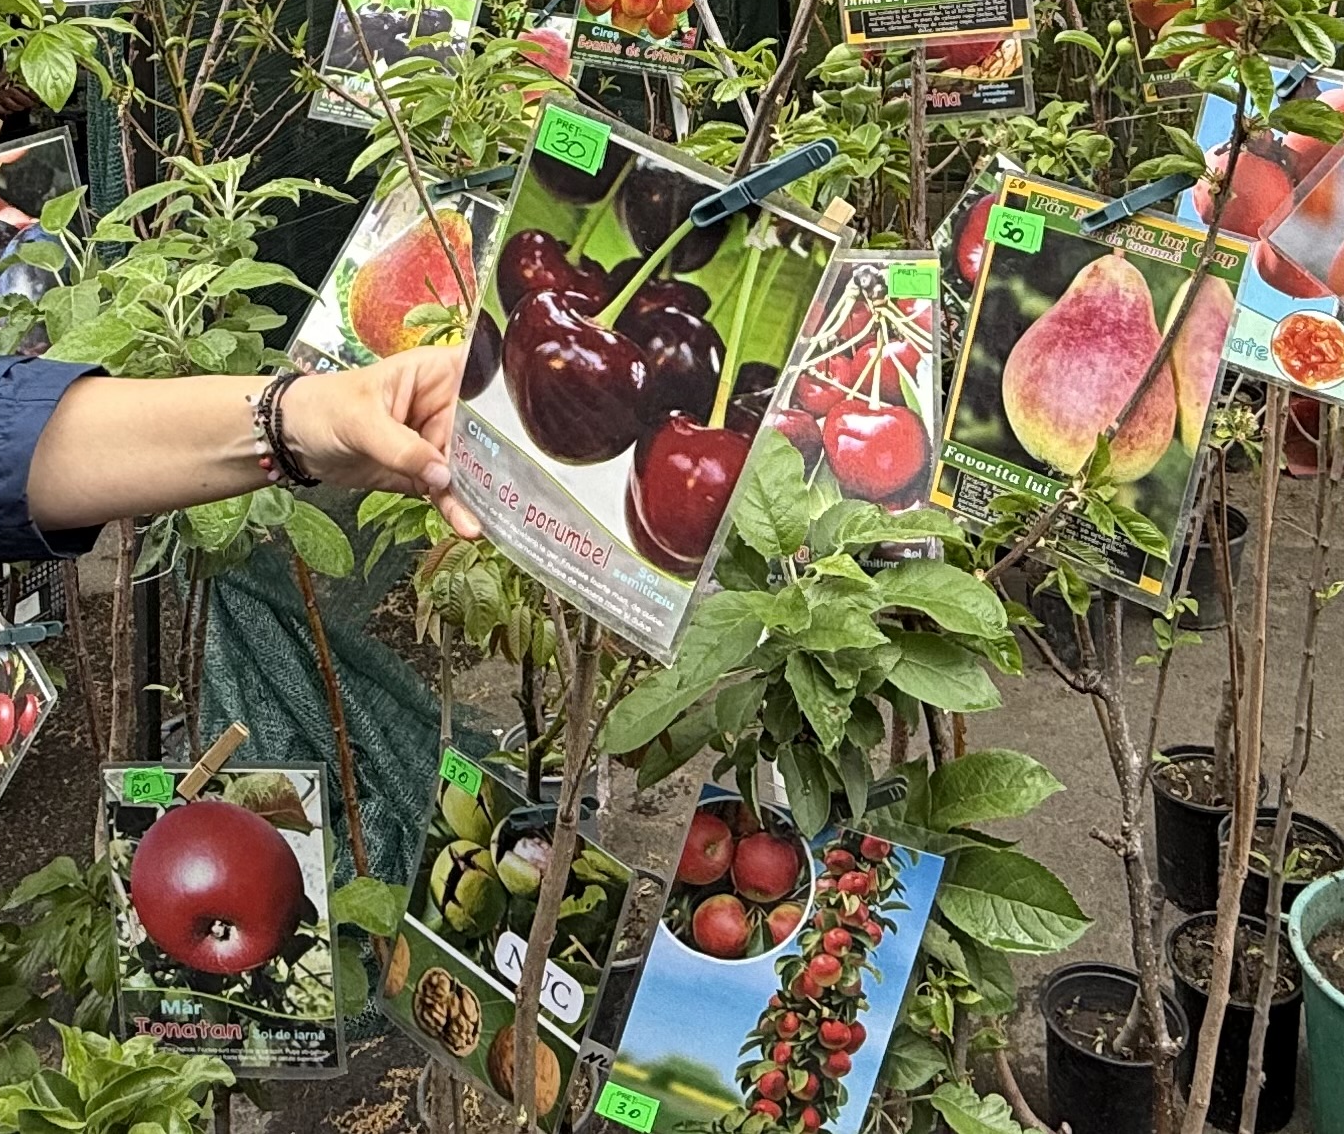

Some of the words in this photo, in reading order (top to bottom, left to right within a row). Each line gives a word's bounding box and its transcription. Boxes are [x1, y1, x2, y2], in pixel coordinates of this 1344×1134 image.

[625, 42, 641, 58] de
[551, 132, 586, 158] 30
[999, 221, 1024, 243] 50
[1032, 194, 1068, 215] Păr
[1159, 231, 1189, 253] lui
[1191, 243, 1239, 269] Cap
[943, 444, 1021, 486] Favorita
[1024, 474, 1051, 498] lui
[498, 481, 520, 511] de
[523, 501, 615, 570] porumbel
[448, 765, 469, 784] 30
[160, 999, 203, 1016] Măr
[133, 1016, 243, 1041] Ionatan
[275, 1028, 291, 1041] de
[614, 1102, 642, 1120] 30
